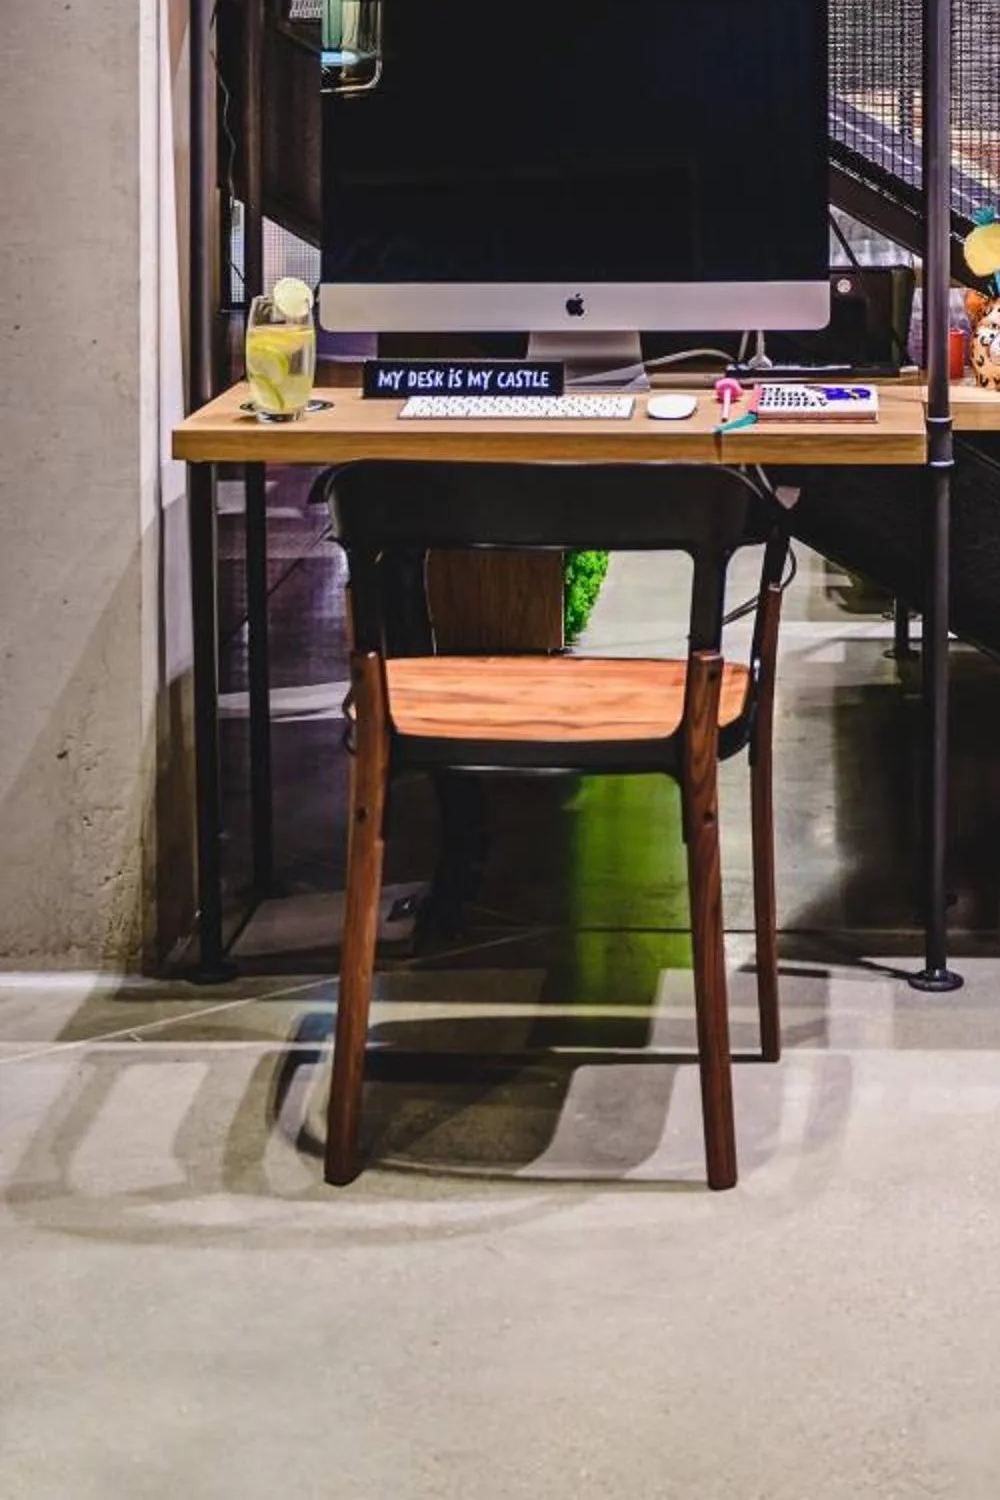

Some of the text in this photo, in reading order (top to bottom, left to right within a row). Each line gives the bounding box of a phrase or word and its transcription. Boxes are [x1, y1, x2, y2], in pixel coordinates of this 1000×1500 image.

[378, 369, 404, 390] MY
[407, 369, 445, 389] DESK
[467, 369, 494, 390] MY
[497, 369, 550, 389] CASTLE
